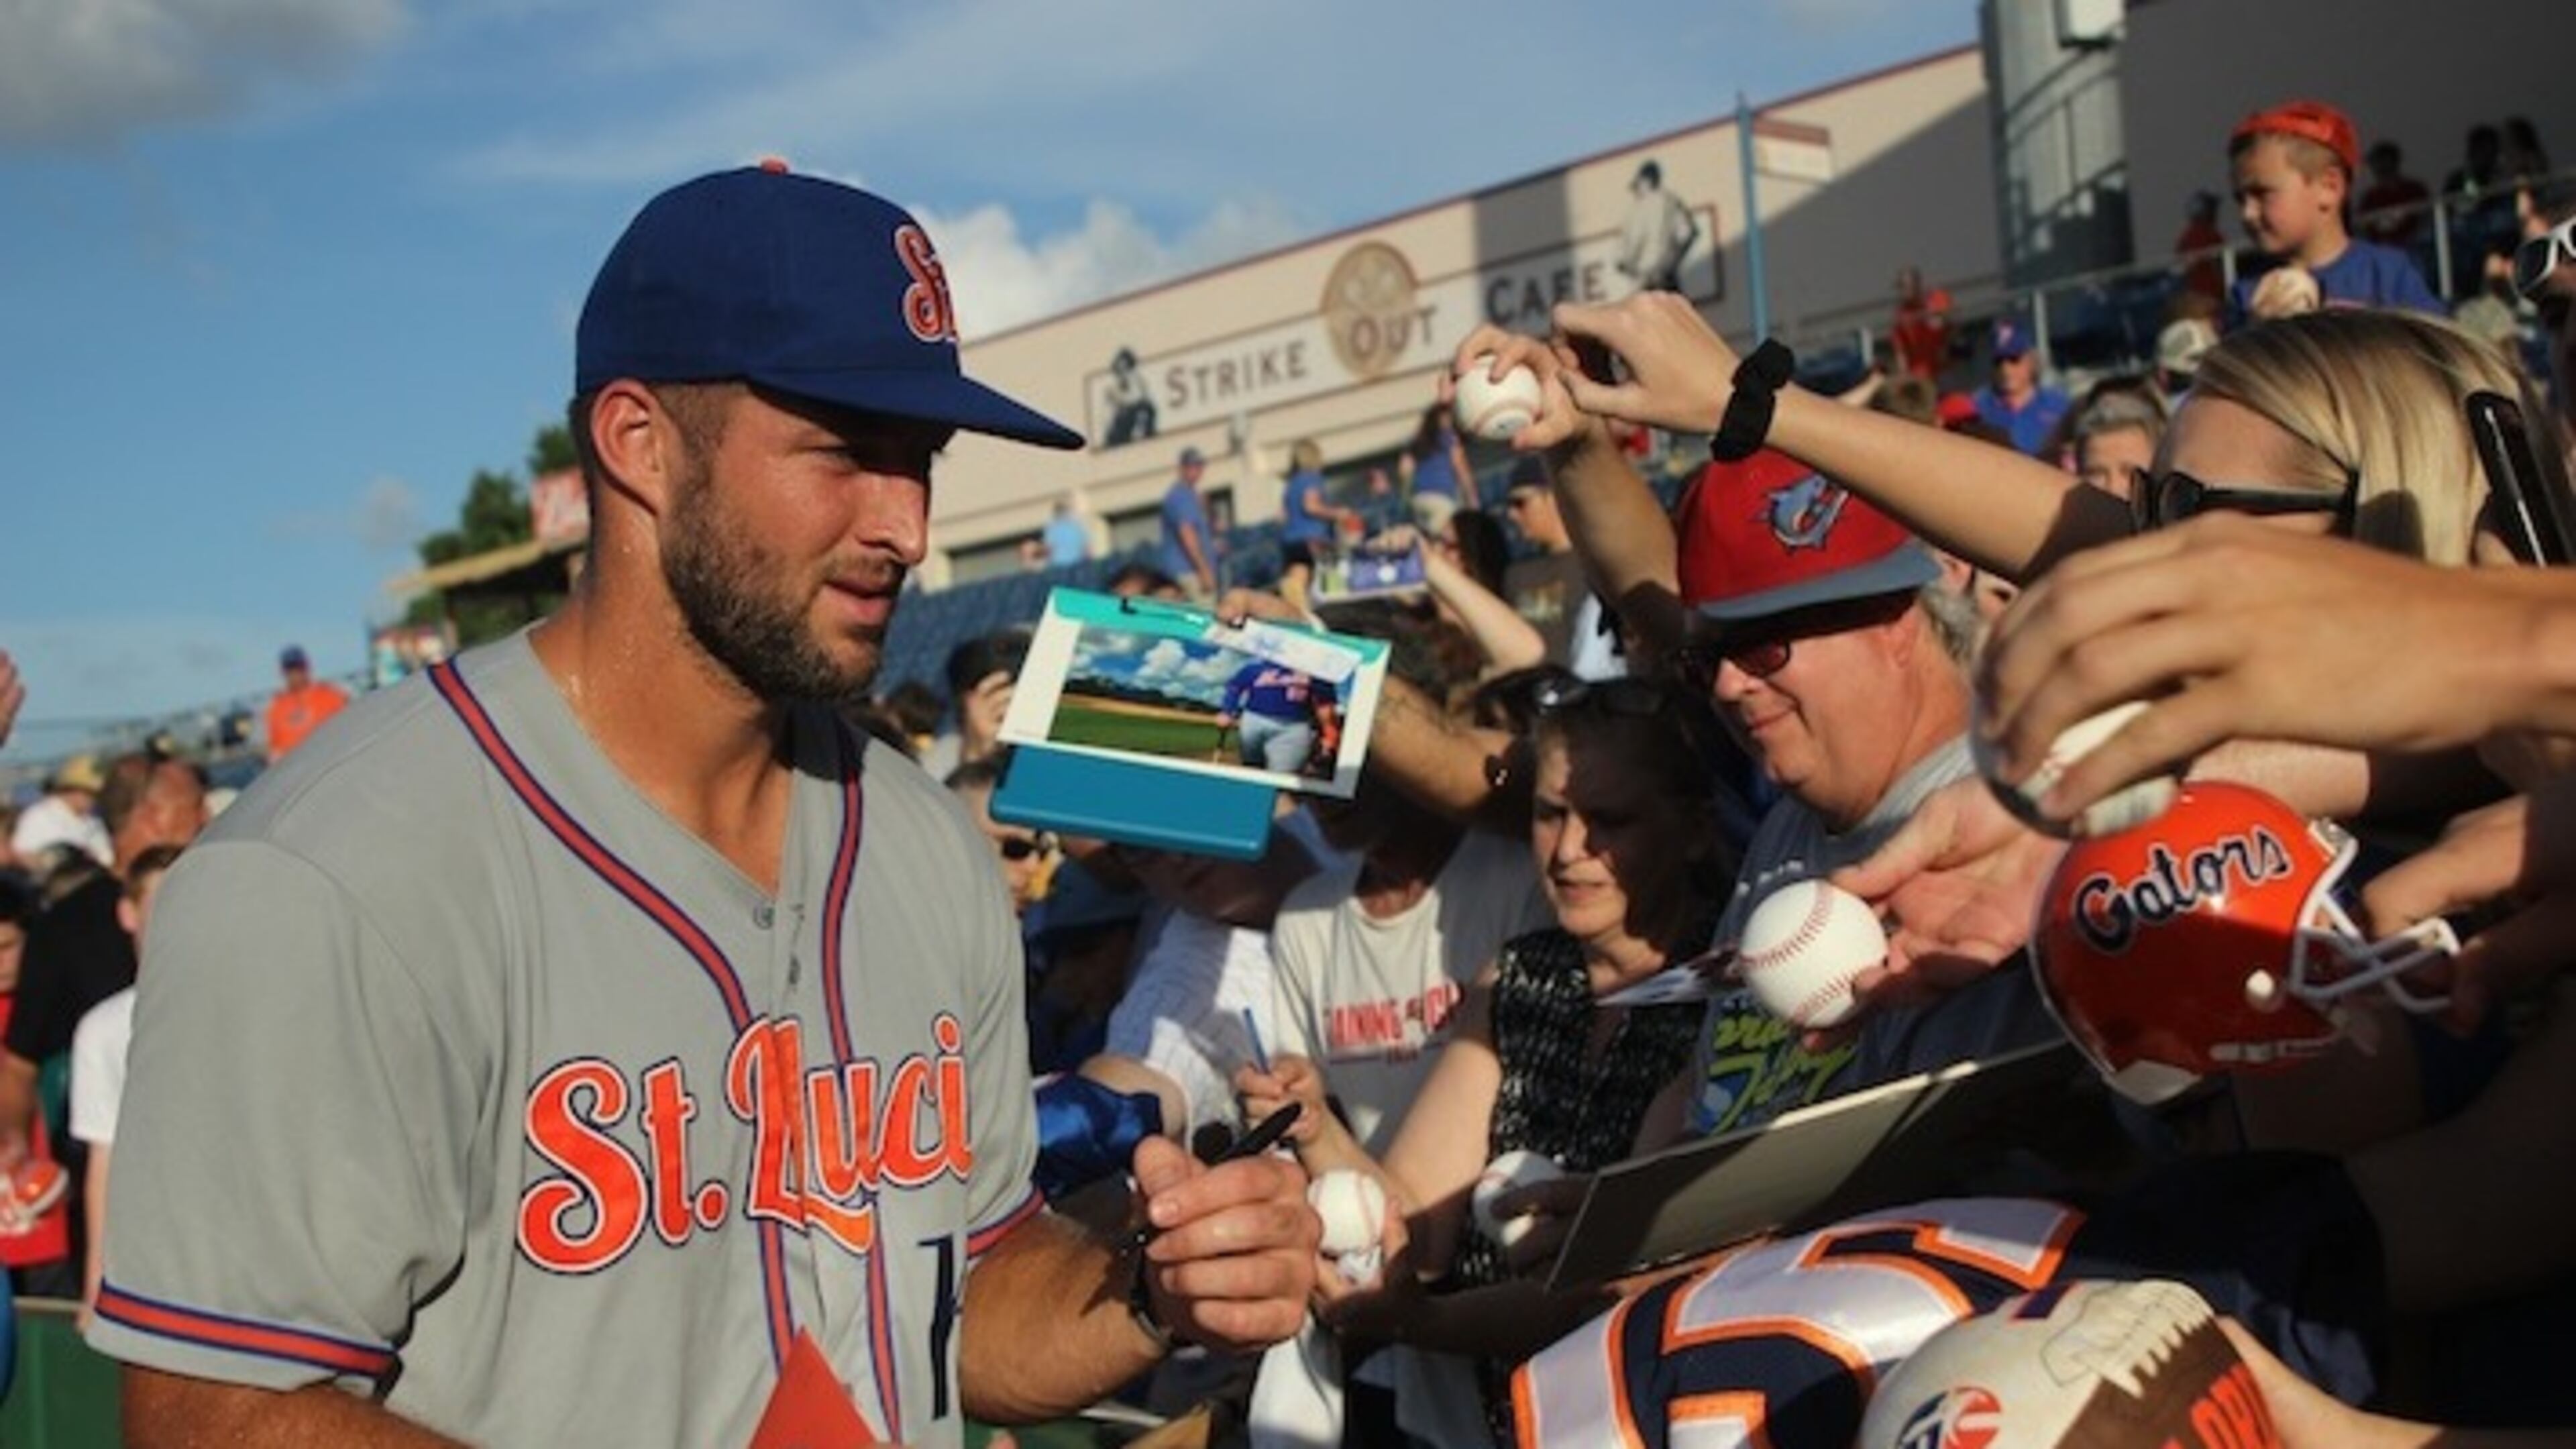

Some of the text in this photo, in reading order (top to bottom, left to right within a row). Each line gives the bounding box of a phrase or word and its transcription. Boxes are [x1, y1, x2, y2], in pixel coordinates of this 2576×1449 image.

[1165, 339, 1307, 408] STRIKE
[1350, 305, 1438, 362] OUT
[2074, 825, 2294, 954] Gators
[517, 1057, 729, 1275] St.
